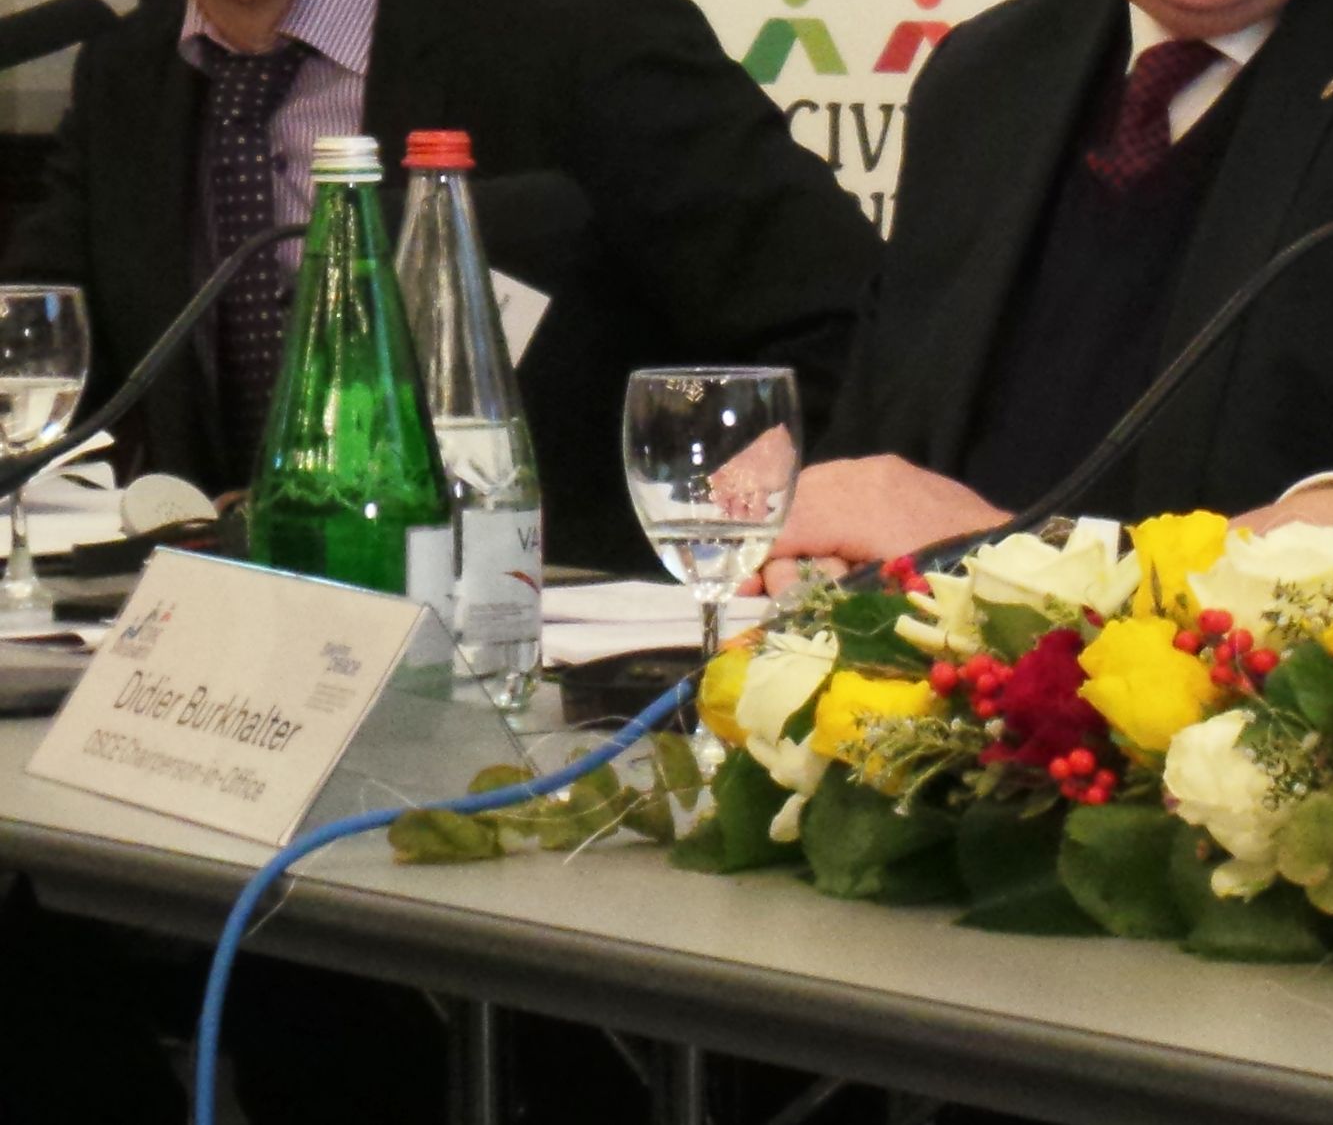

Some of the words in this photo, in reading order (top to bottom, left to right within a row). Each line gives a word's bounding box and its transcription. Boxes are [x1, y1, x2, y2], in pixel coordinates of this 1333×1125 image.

[784, 98, 908, 173] CIV
[113, 670, 185, 721] Didier
[177, 685, 302, 751] Burkhalter
